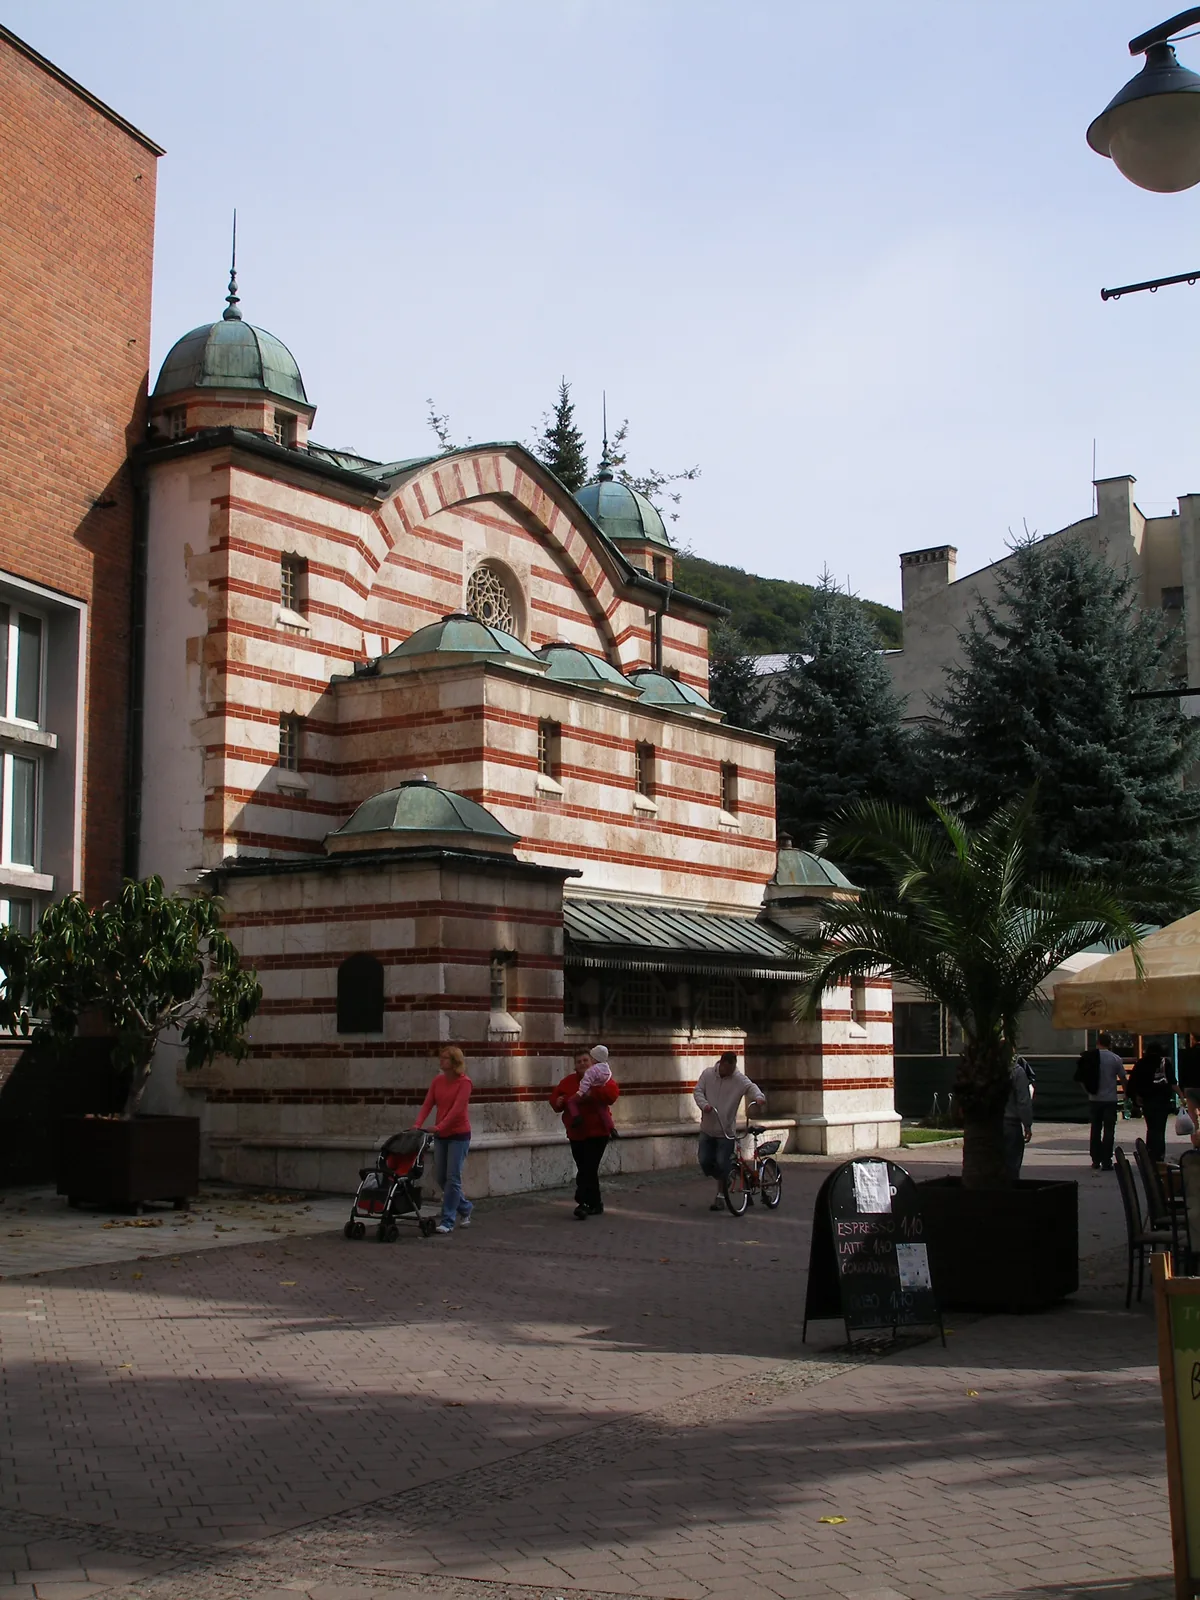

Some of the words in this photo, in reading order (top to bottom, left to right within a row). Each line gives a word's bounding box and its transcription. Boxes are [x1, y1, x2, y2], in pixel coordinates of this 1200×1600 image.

[837, 1220, 895, 1236] ESPRESSO
[901, 1216, 923, 1237] 1,10
[839, 1241, 868, 1254] LATTE
[873, 1237, 892, 1255] 1,40
